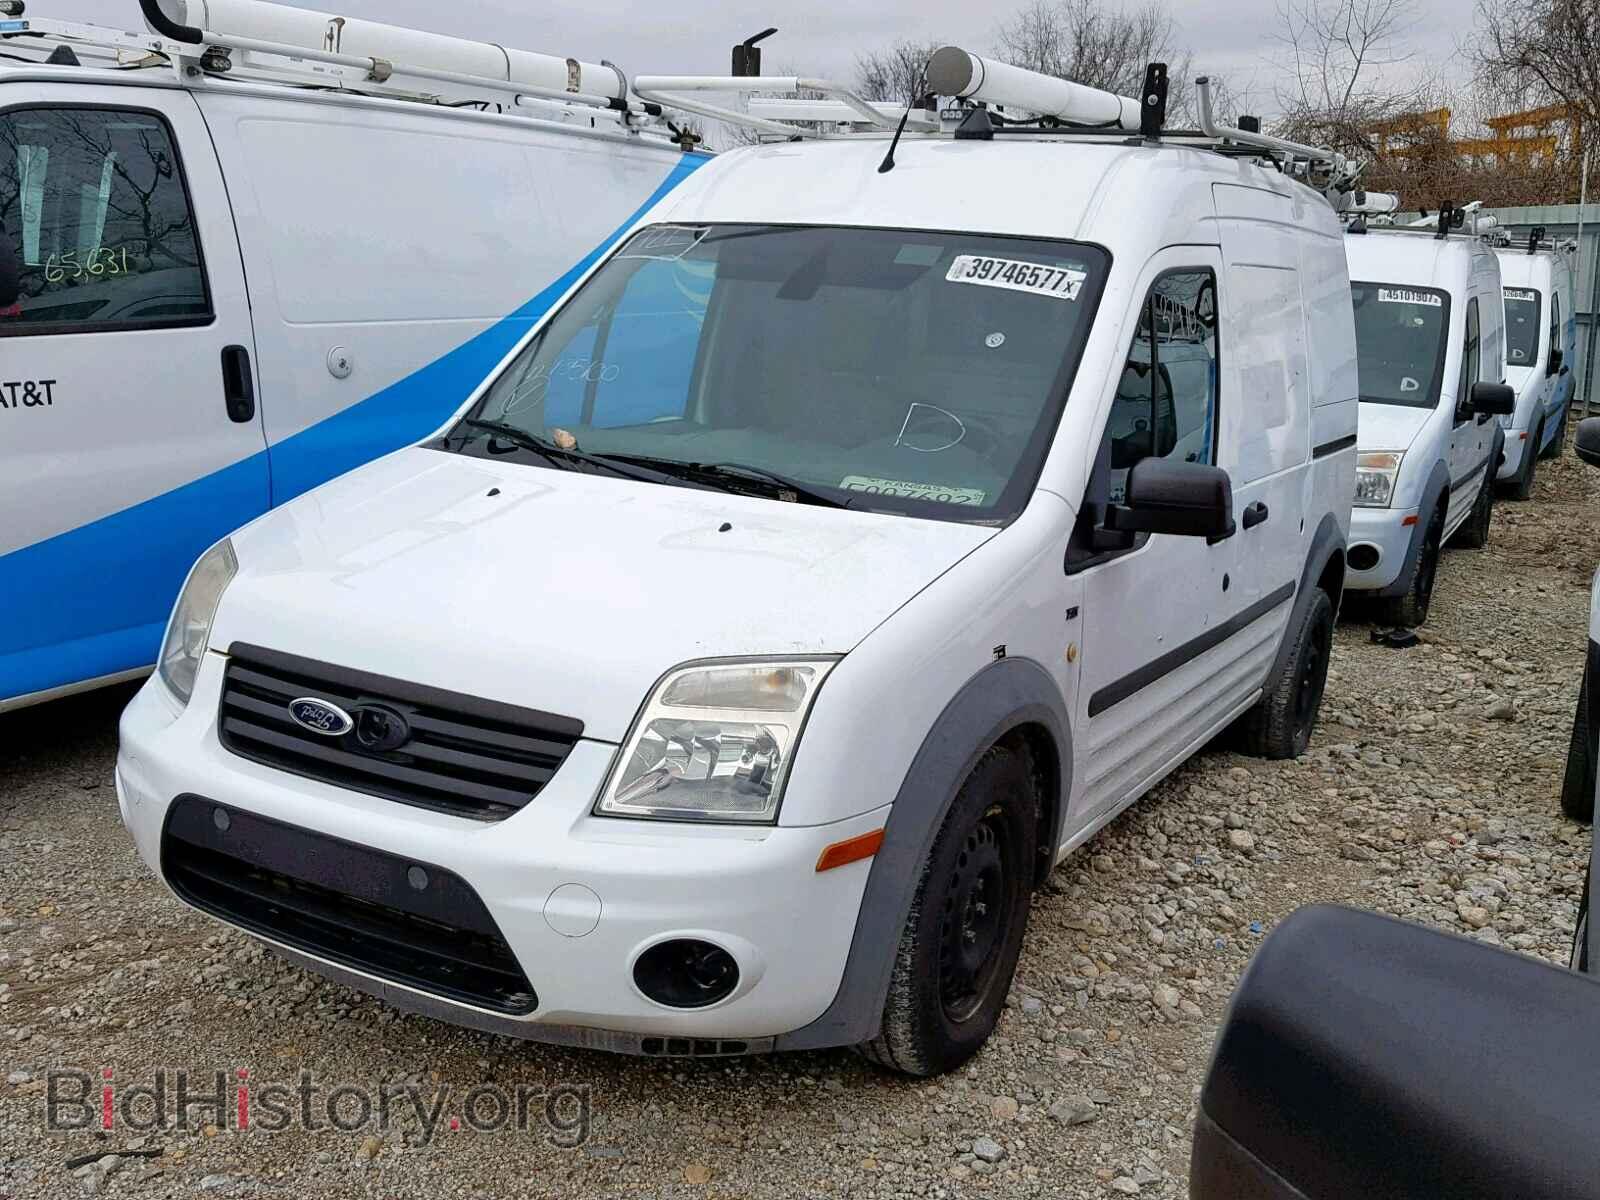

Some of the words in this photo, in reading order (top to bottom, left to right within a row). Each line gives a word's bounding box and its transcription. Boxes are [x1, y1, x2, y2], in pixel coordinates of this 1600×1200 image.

[45, 247, 128, 283] 65,631
[893, 402, 967, 453] D
[300, 704, 335, 730] Ford
